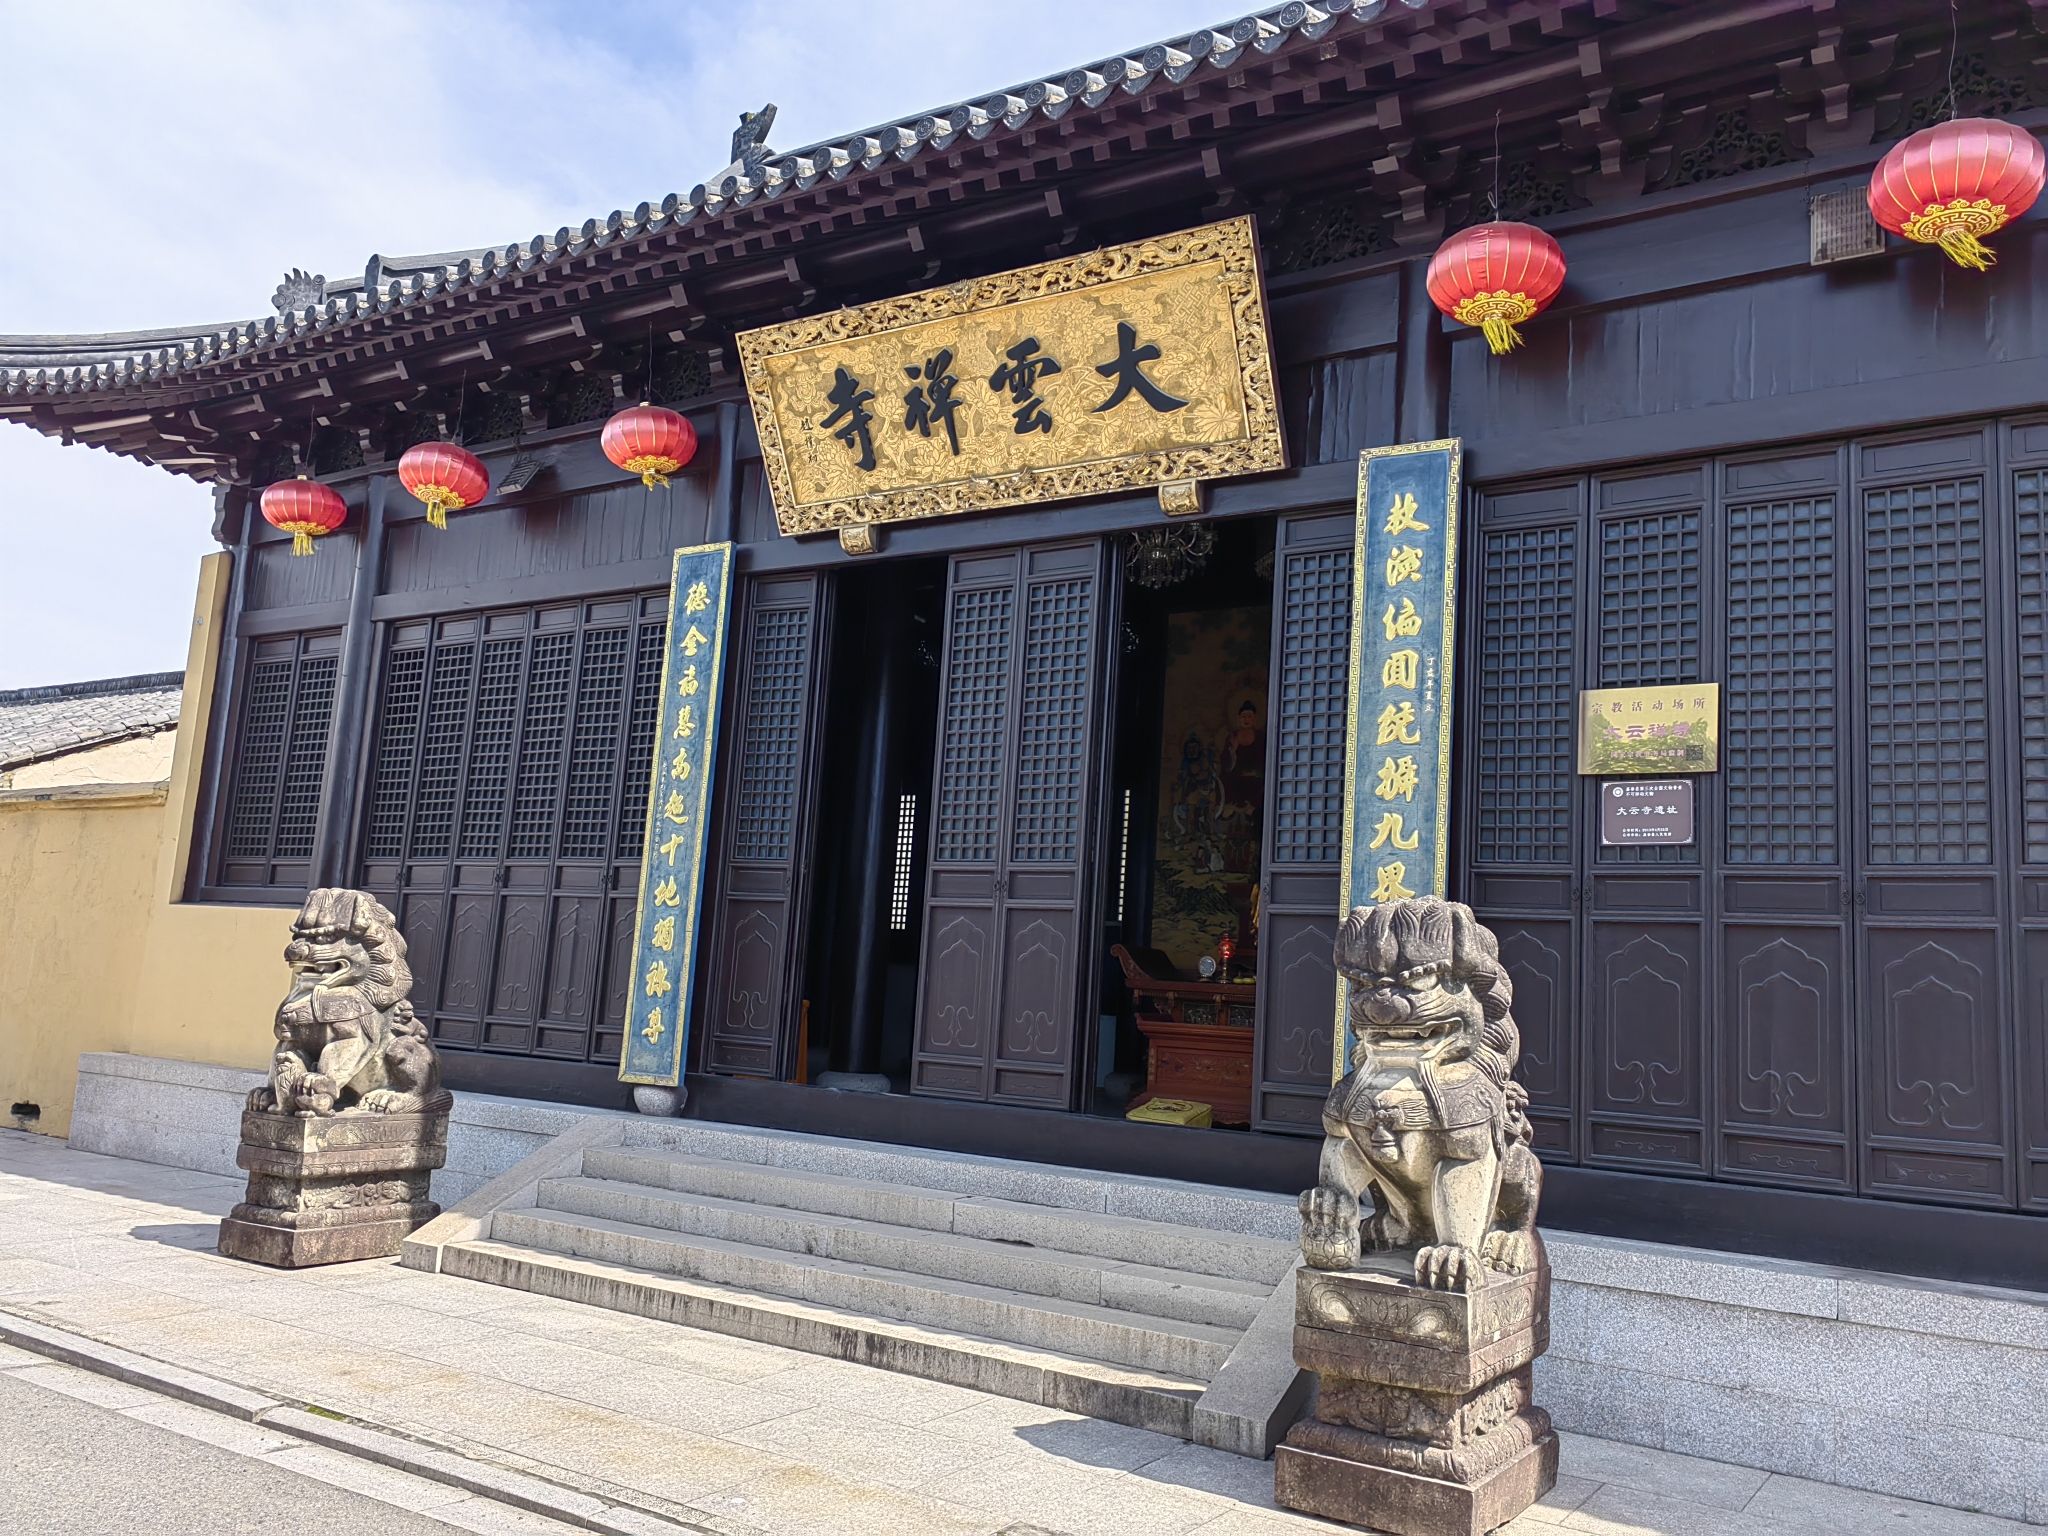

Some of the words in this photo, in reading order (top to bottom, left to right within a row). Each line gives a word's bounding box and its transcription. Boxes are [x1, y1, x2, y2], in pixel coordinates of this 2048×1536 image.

[1591, 697, 1706, 714] 宗教活动场所
[1616, 805, 1679, 816] 大云寺遗址
